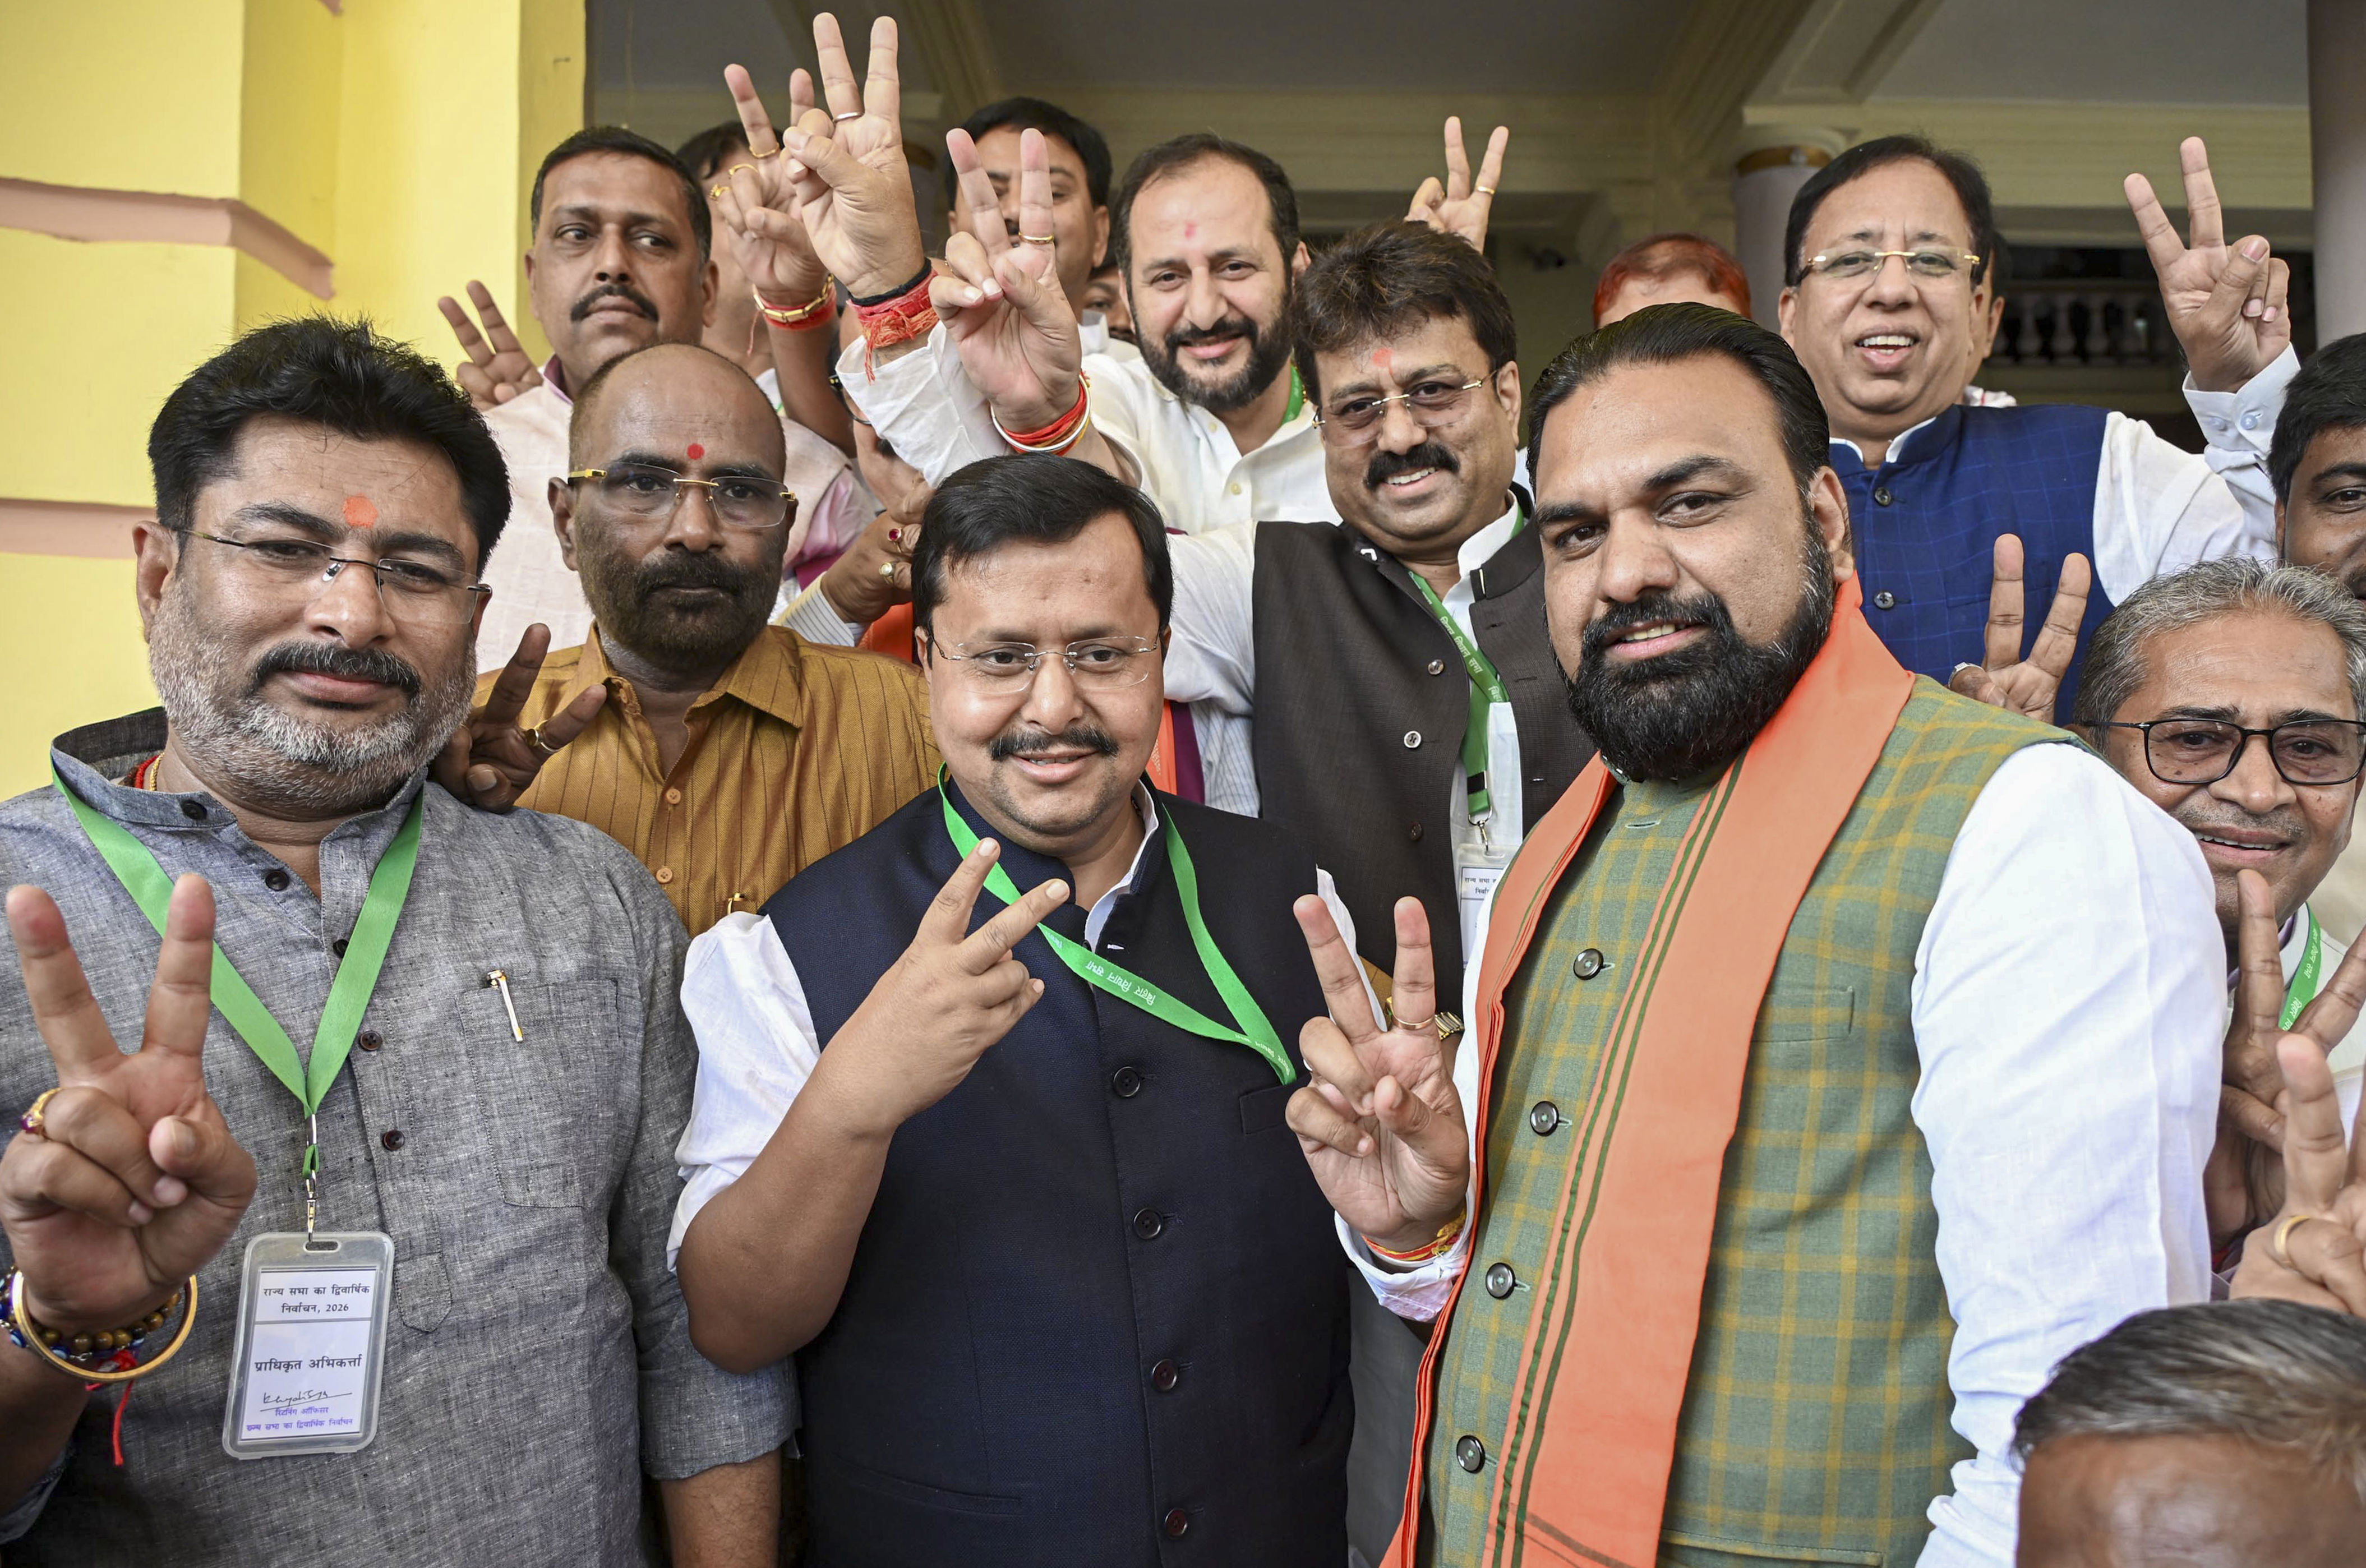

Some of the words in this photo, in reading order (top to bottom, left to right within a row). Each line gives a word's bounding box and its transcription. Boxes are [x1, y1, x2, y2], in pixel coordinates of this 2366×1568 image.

[1469, 658, 1483, 673] सभा
[1086, 961, 1104, 976] सभा
[2304, 963, 2313, 979] सभा
[1107, 972, 1132, 992] विधान
[1133, 985, 1156, 1006] बिहार
[2290, 997, 2302, 1018] बिहार
[289, 1287, 308, 1295] सभा
[313, 1286, 326, 1295] का
[331, 1283, 370, 1295] द्विवार्षिक
[281, 1302, 320, 1313] निर्वाचन,
[326, 1304, 349, 1312] 2026
[255, 1358, 302, 1372] प्राधिकृत
[309, 1354, 362, 1368] अभिकर्त्ता
